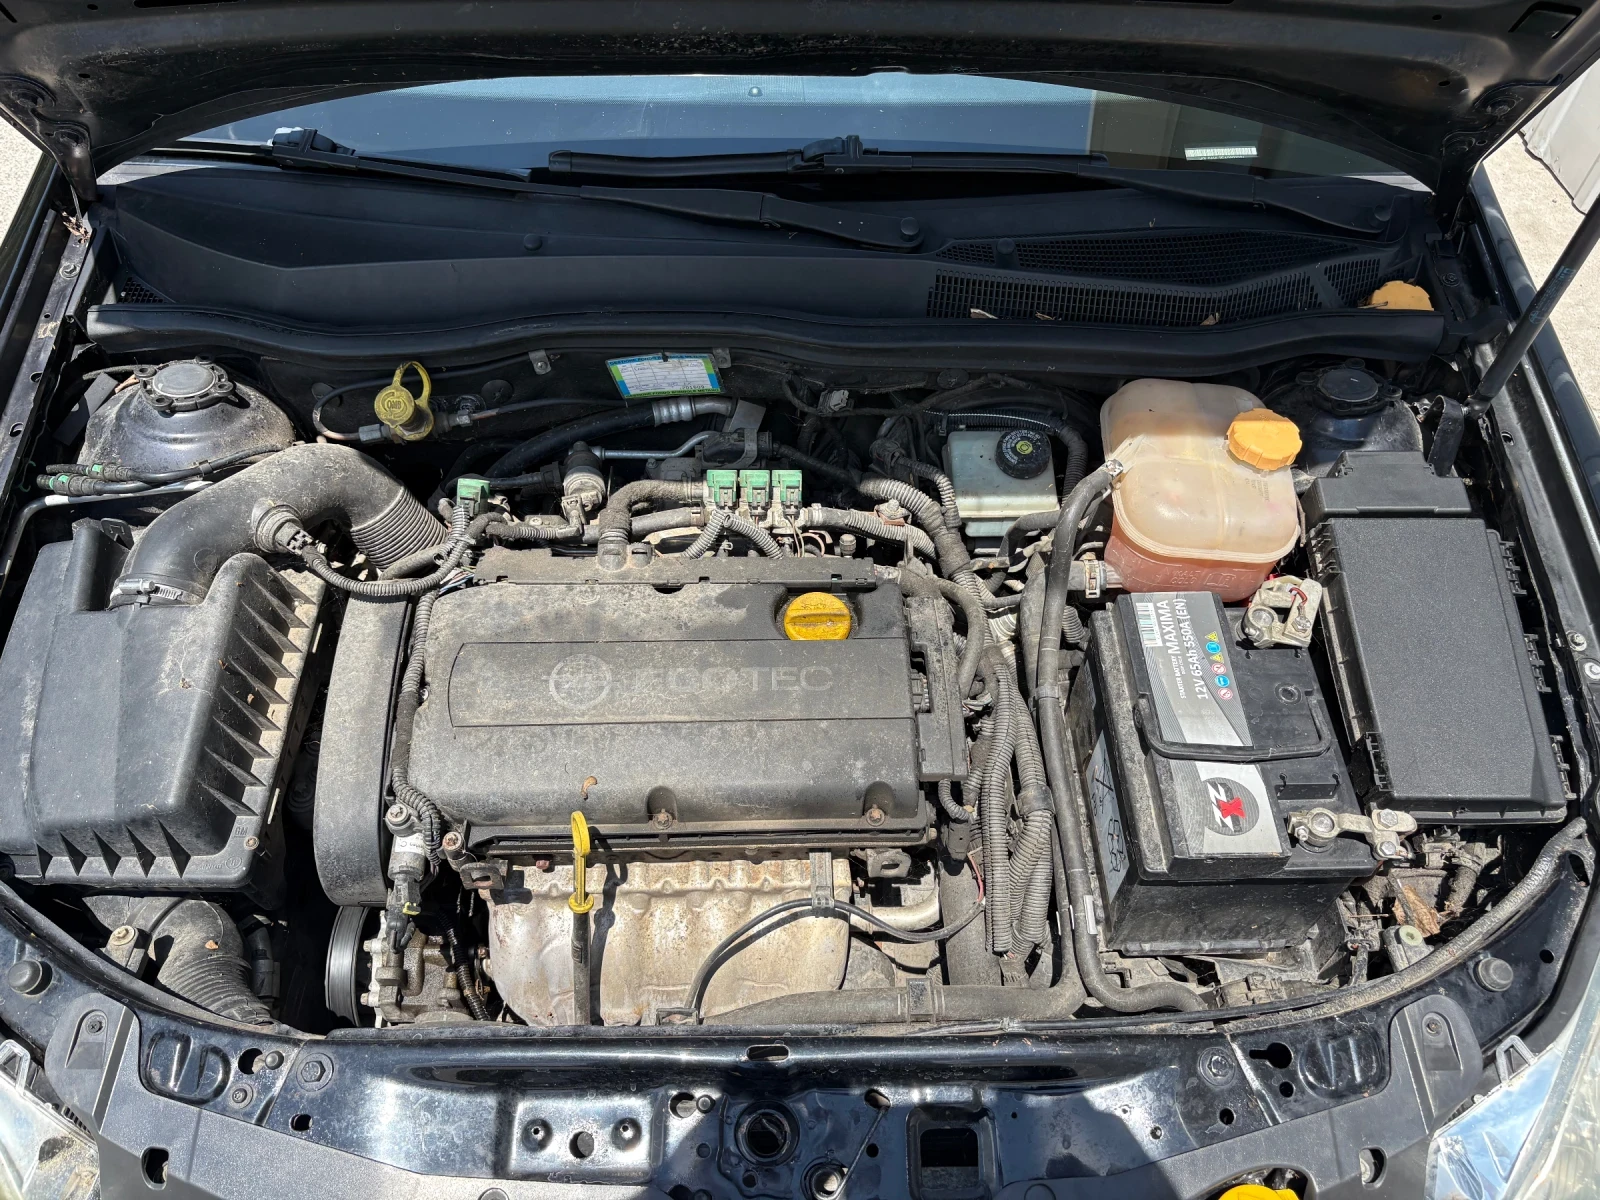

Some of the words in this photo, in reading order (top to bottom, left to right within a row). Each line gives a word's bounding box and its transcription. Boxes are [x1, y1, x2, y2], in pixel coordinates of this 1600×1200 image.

[1174, 598, 1190, 618] (EN)
[1156, 599, 1181, 654] MAXIMA
[1179, 621, 1196, 650] 550A
[1185, 649, 1203, 677] 65Ah
[631, 665, 834, 694] ECOTEC
[1194, 677, 1209, 700] 12V
